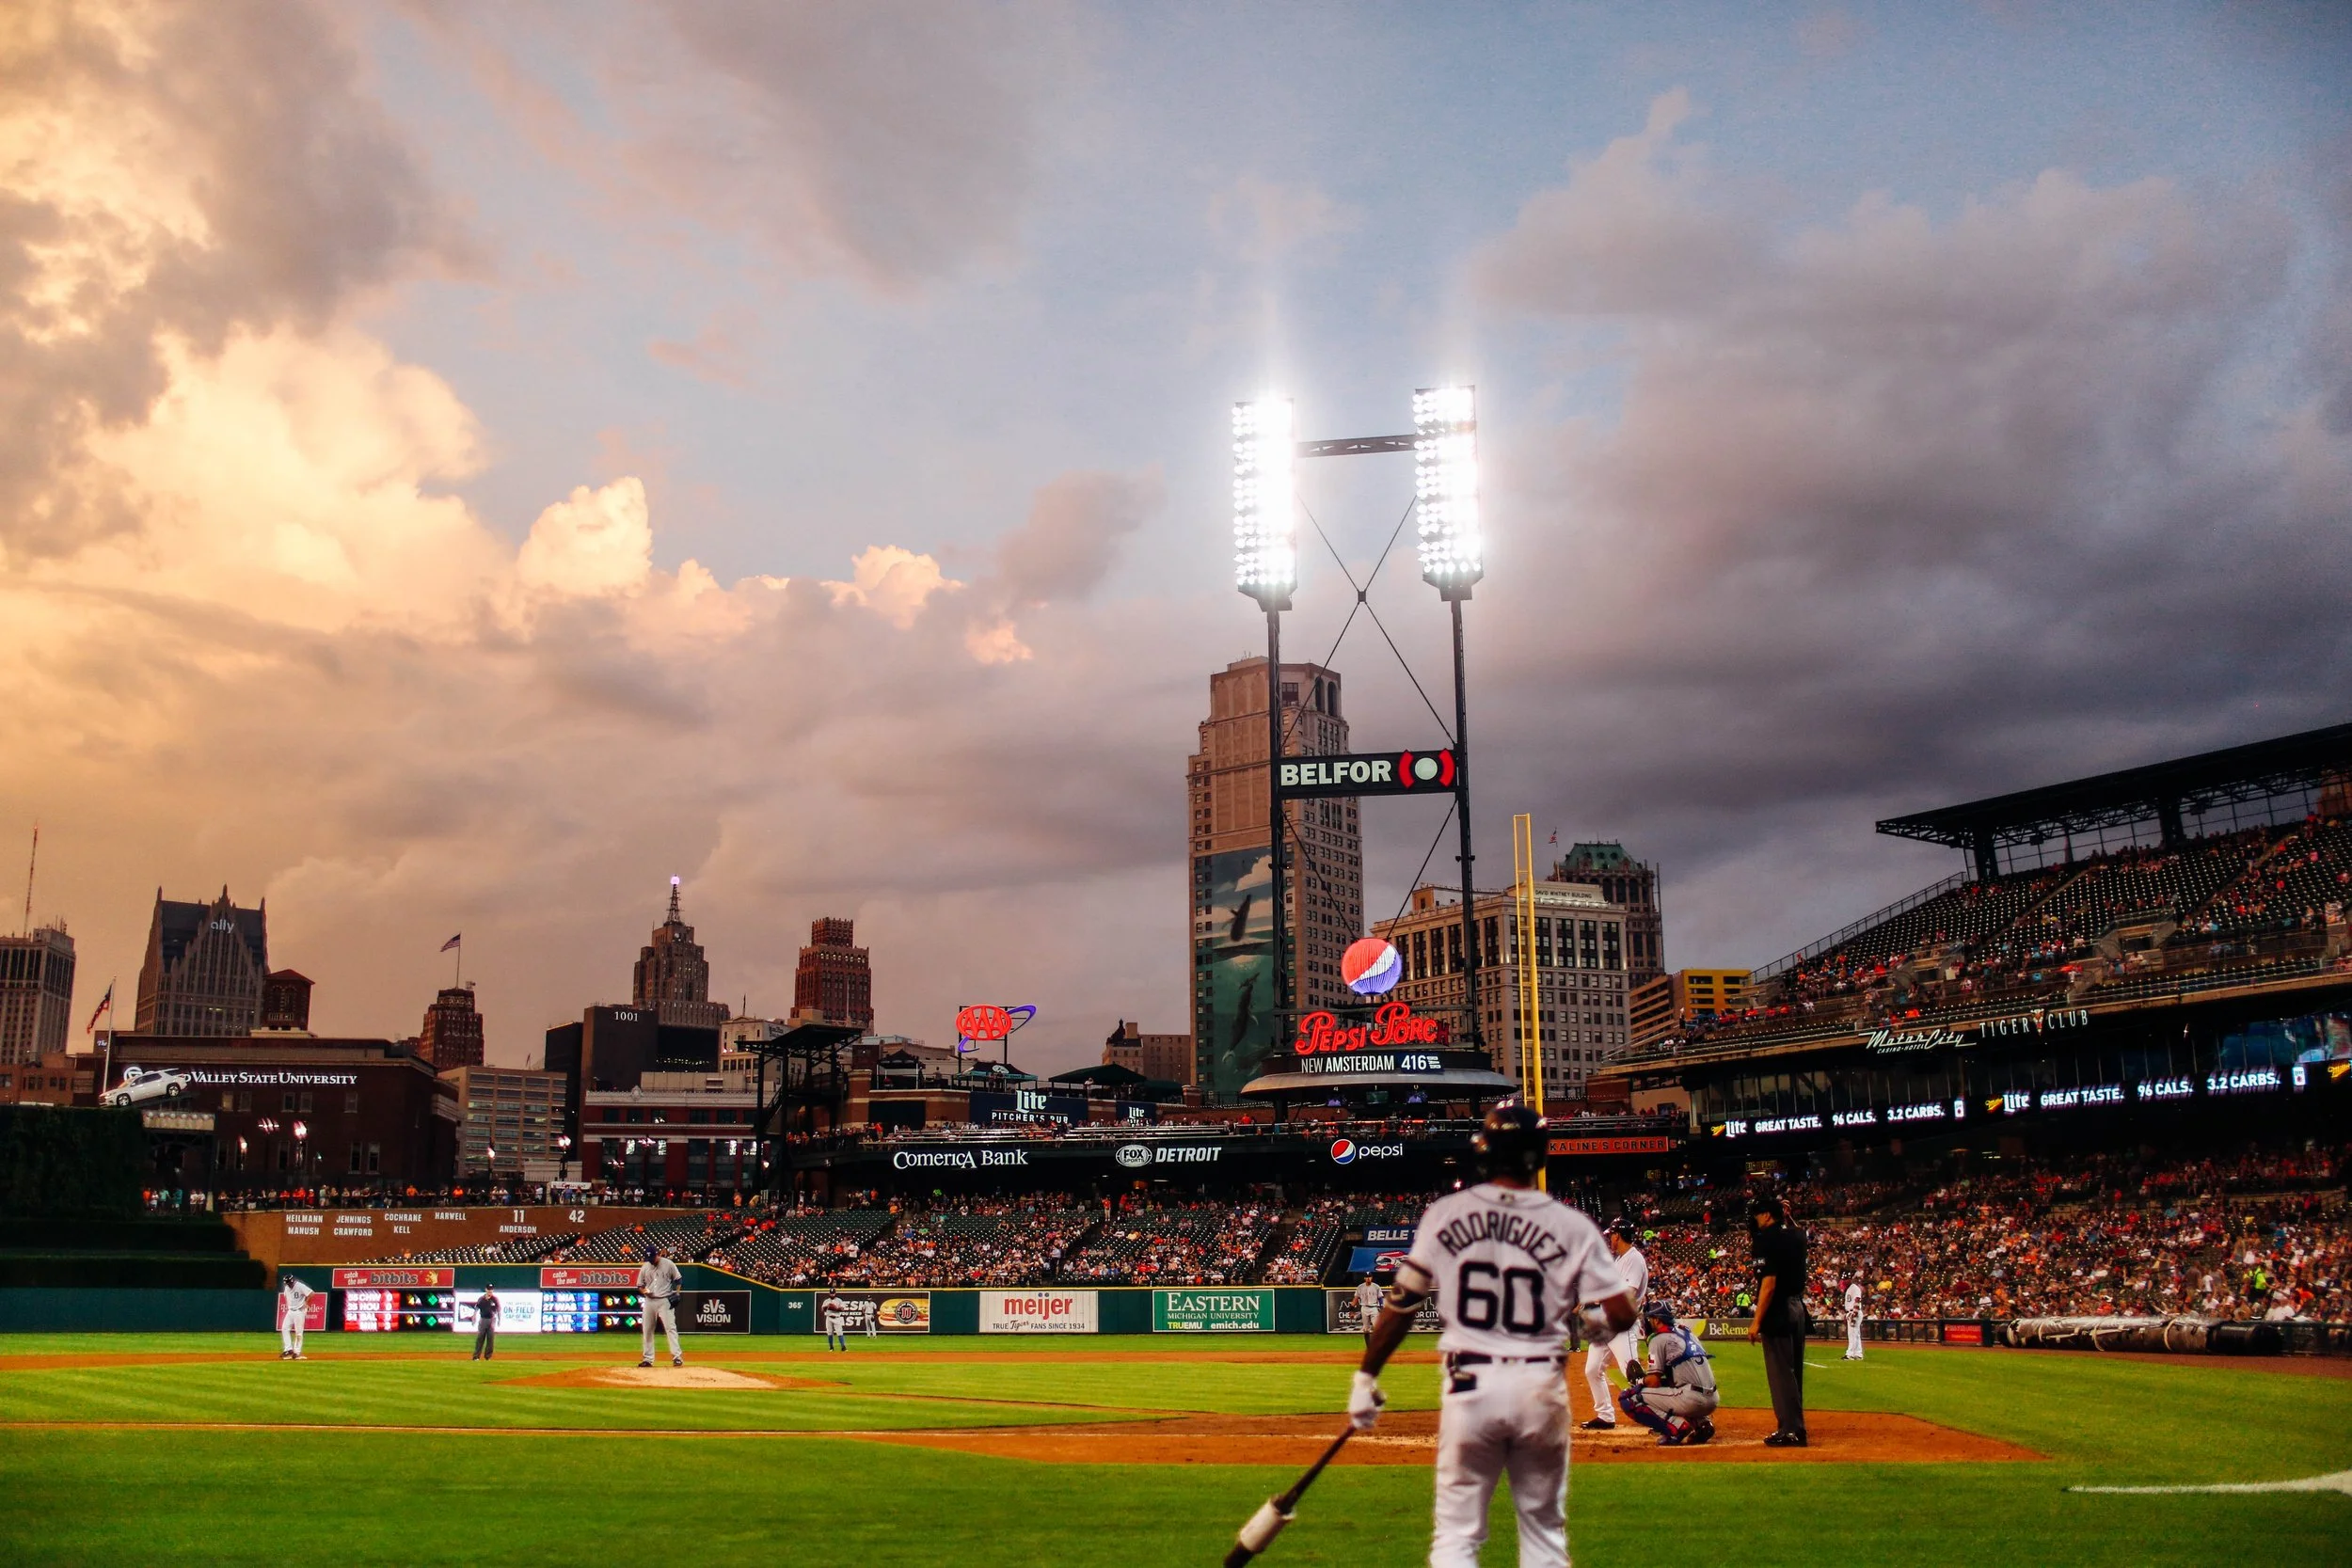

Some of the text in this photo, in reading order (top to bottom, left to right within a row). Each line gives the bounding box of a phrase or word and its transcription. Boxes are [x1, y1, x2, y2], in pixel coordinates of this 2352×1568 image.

[1280, 760, 1391, 785] BELFOR
[210, 919, 234, 933] ally
[614, 1011, 638, 1022] 1001
[960, 1006, 1008, 1039] AAA
[1979, 1009, 2089, 1038] TIGER CLUB
[1301, 1054, 1394, 1073] NEW AMSTERDAM
[1401, 1054, 1427, 1070] 416
[2002, 1094, 2029, 1112] Lite
[2040, 1091, 2079, 1106] GREAT
[2081, 1087, 2124, 1102] TASTE.
[2137, 1085, 2153, 1097] 96
[2154, 1081, 2193, 1096] CALS.
[2207, 1077, 2228, 1091] 3.2
[2230, 1072, 2280, 1088] CARBS.
[1016, 1089, 1046, 1113] Lite
[992, 1112, 1045, 1122] PITCHER'S
[1129, 1106, 1144, 1118] Lite
[1725, 1120, 1747, 1138] Lite
[1755, 1119, 1787, 1132] GREAT
[1788, 1117, 1822, 1130] TASTE.
[1833, 1115, 1844, 1126] 96
[1846, 1112, 1876, 1125] CALS.
[1887, 1109, 1903, 1121] 3.2
[1905, 1105, 1946, 1119] CARBS.
[1613, 1139, 1664, 1149] CORNER
[981, 1148, 1028, 1166] Bank
[1123, 1149, 1144, 1159] FOX
[1155, 1147, 1222, 1163] DETROIT
[1359, 1143, 1403, 1160] pepsi
[286, 1214, 324, 1223] HEILMANN
[336, 1215, 372, 1224] JENNINGS
[384, 1212, 422, 1222] COCHRANE
[435, 1212, 467, 1221] HARWELL
[514, 1210, 524, 1223] 11
[569, 1210, 585, 1223] 42
[288, 1227, 320, 1235] MANUSH
[333, 1227, 373, 1237] CRAWFORD
[393, 1226, 411, 1234] KELL
[499, 1225, 537, 1234] ANDERSON
[1367, 1229, 1409, 1241] BELLE
[1437, 1210, 1567, 1272] RODRIGUEZ
[371, 1271, 419, 1285] bitbits
[580, 1271, 630, 1285] bitbits
[1168, 1292, 1260, 1312] EASTERN
[1457, 1260, 1545, 1336] 60
[358, 1303, 379, 1311] HOU
[1004, 1292, 1073, 1320] meijer
[696, 1314, 731, 1323] VISION
[1211, 1321, 1260, 1329] emich.edu
[1708, 1323, 1749, 1336] BeRema
